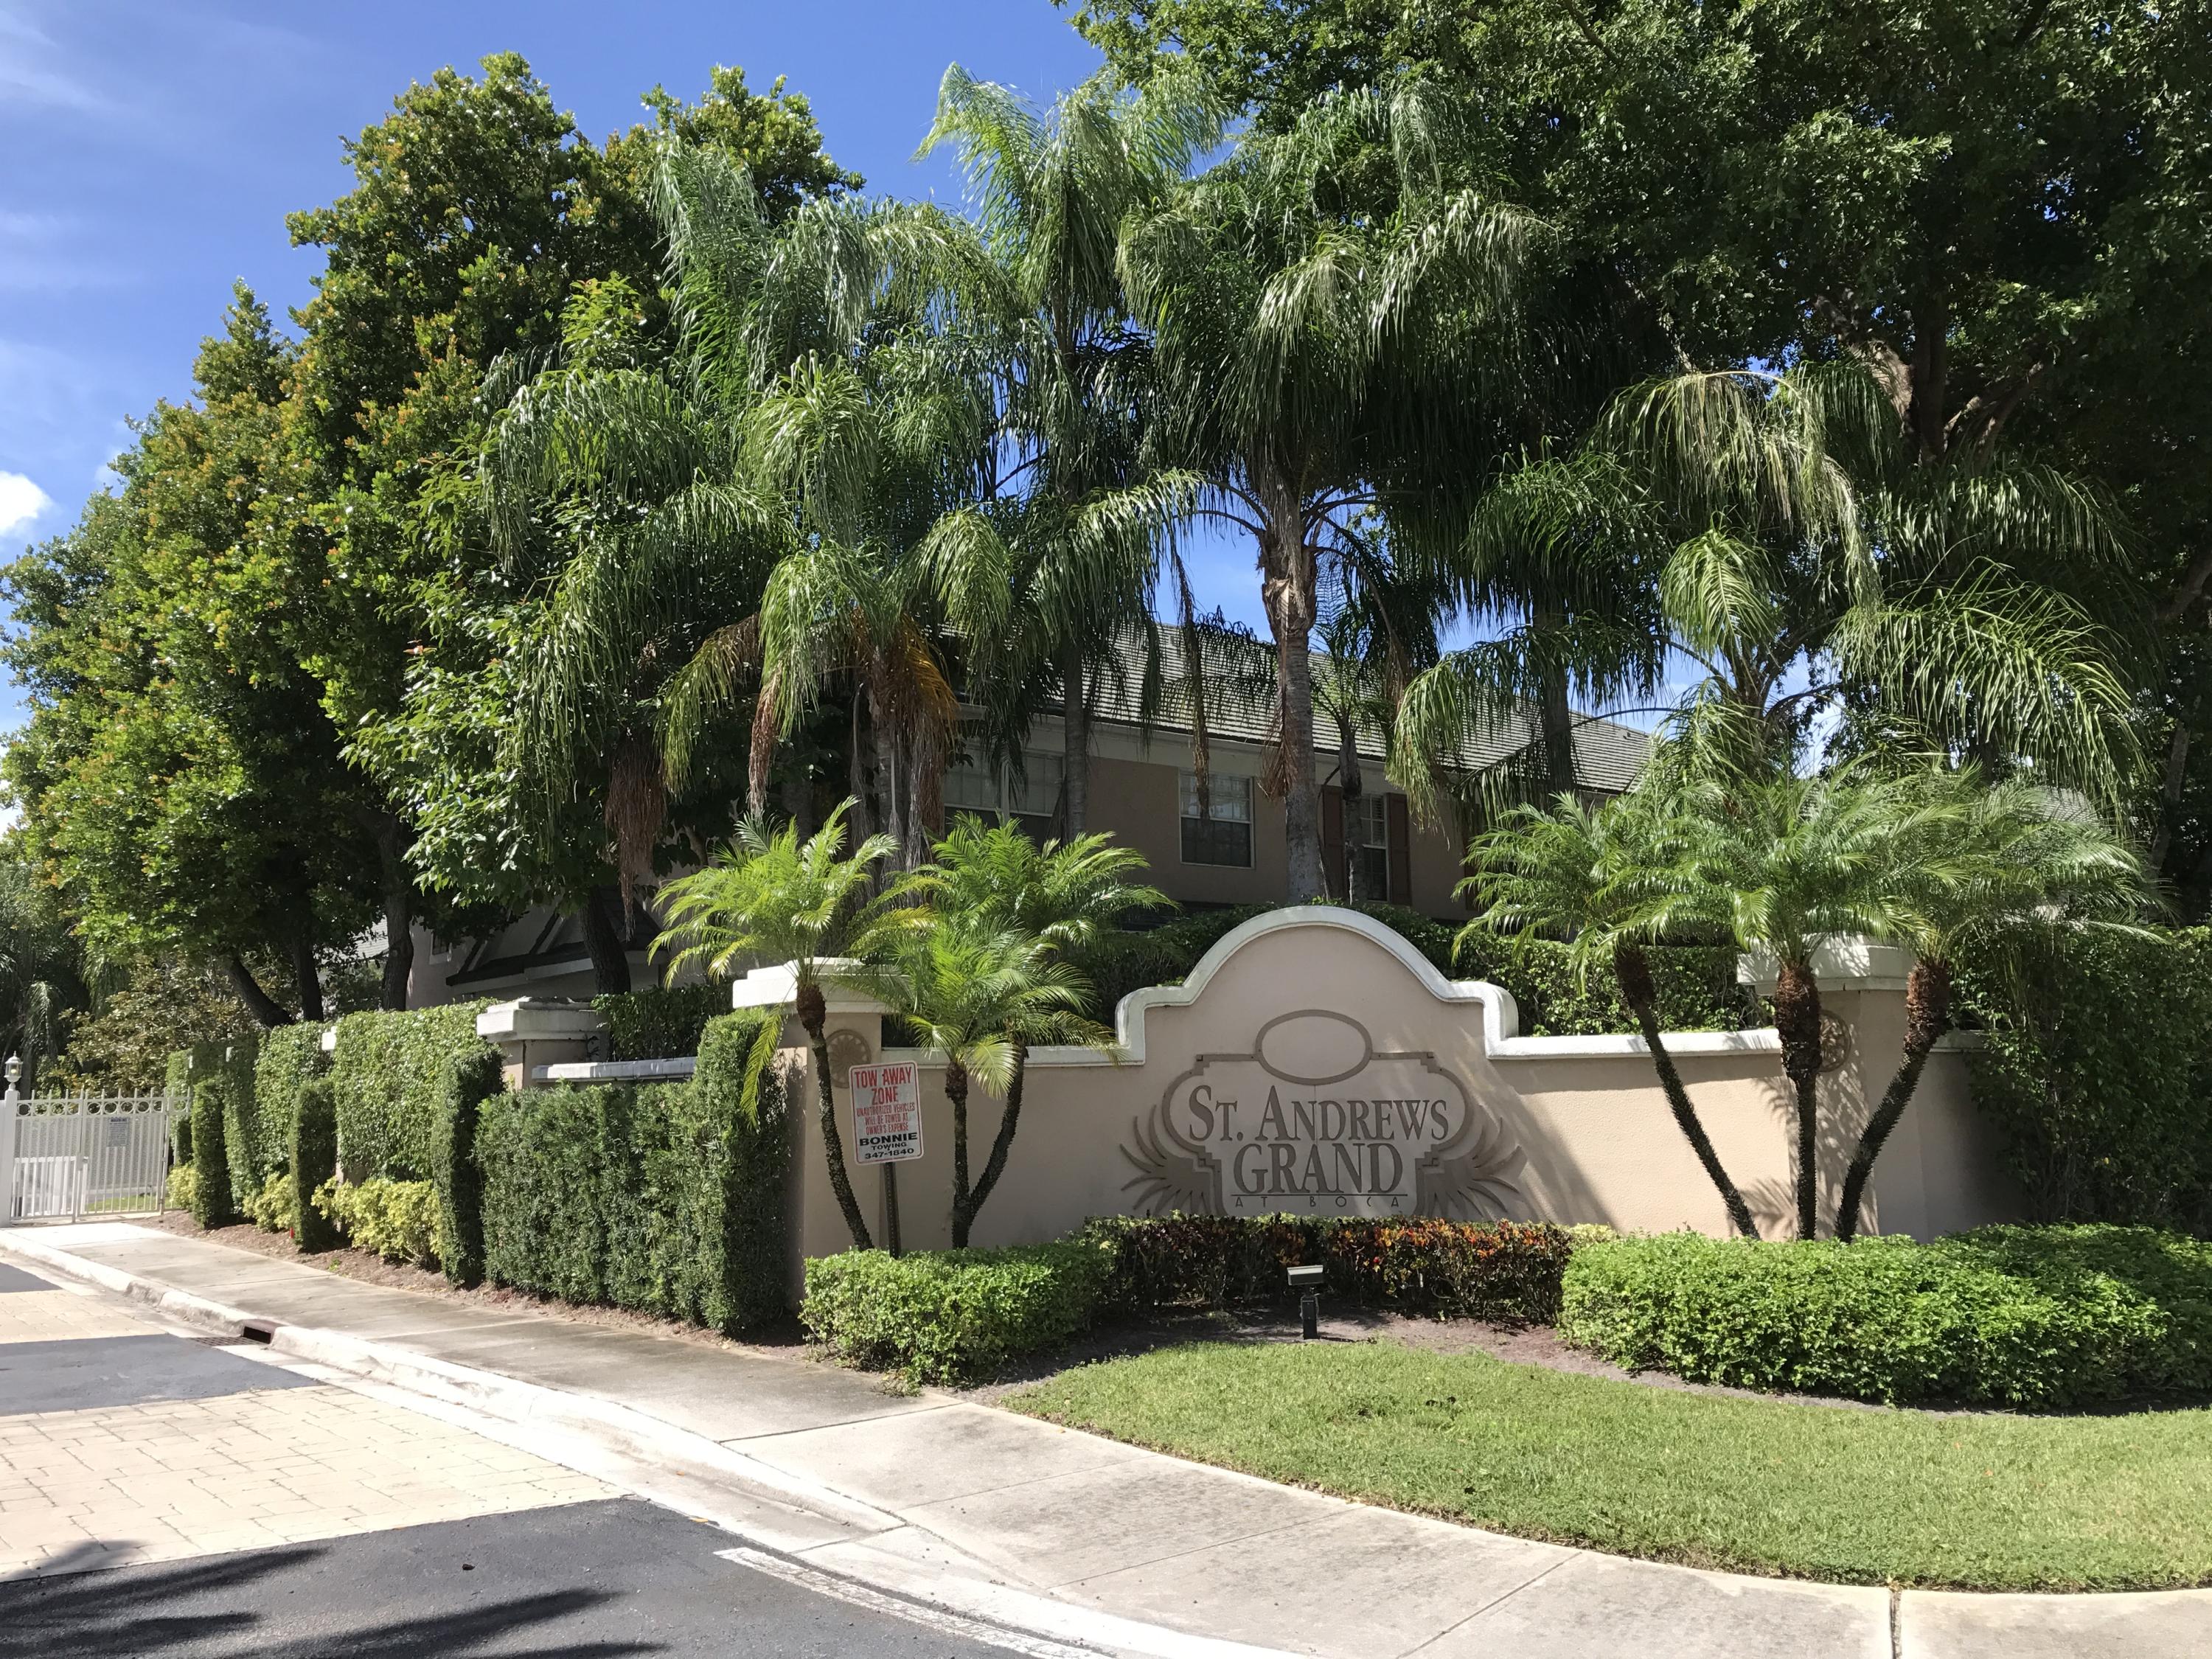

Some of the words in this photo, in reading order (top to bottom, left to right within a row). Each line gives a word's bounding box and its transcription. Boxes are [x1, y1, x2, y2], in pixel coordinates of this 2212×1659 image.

[854, 1070, 877, 1088] TOW
[882, 1066, 912, 1085] AWAY
[872, 1086, 899, 1105] ZONE
[856, 1105, 892, 1117] UNAUTHORIZED
[894, 1102, 915, 1113] VEHICLES
[1189, 1085, 1244, 1141] ST.
[1255, 1085, 1450, 1141] ANDREWS
[865, 1116, 876, 1126] WILL
[877, 1115, 884, 1124] BE
[885, 1114, 901, 1124] TOWED
[902, 1113, 908, 1122] AT
[866, 1124, 887, 1135] OWNER'S
[888, 1122, 909, 1133] EXPENSE
[859, 1133, 918, 1147] BONNIE
[871, 1142, 908, 1151] TOWING
[865, 1148, 915, 1159] 347-1840
[1234, 1143, 1403, 1194] GRAND
[1235, 1196, 1268, 1208] AT
[1310, 1196, 1399, 1208] BOCA
